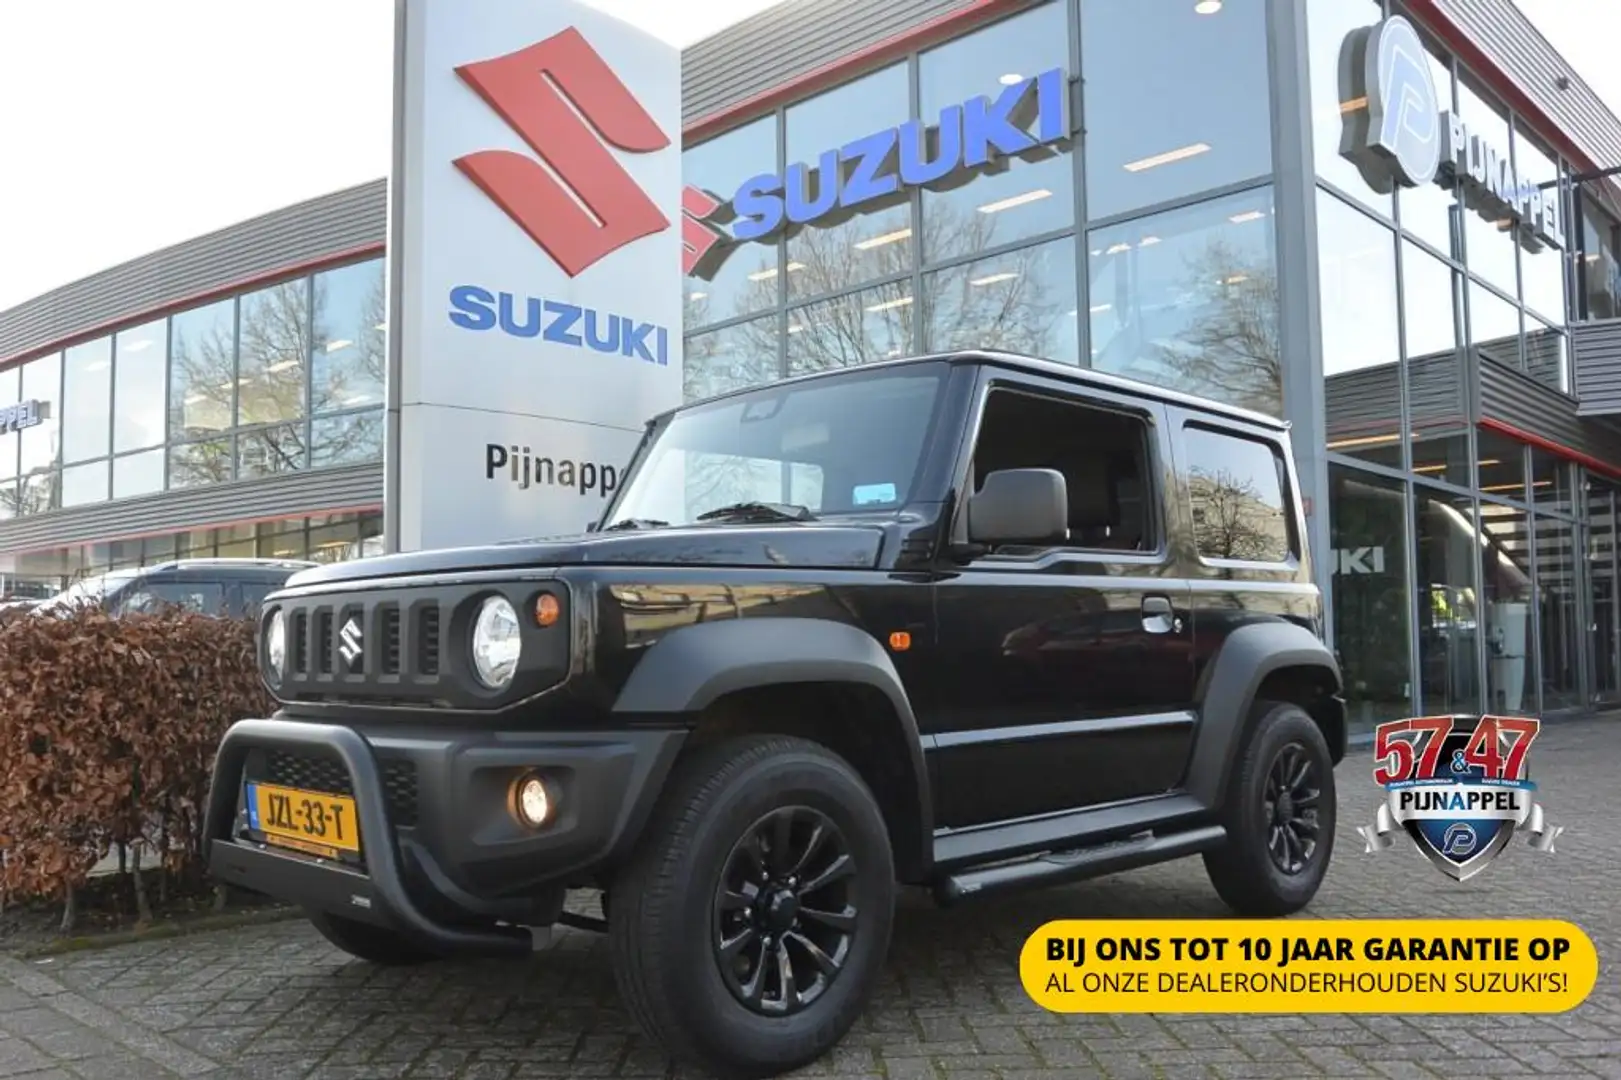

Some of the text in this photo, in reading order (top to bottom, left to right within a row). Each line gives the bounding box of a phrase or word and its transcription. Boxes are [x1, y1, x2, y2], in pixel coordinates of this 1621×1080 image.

[732, 67, 1066, 240] SUZUKI
[1449, 113, 1566, 250] PIJNAPPEL
[448, 284, 668, 366] SUZUKI
[486, 443, 625, 498] Pijnapp
[266, 793, 343, 841] JZL-33-T
